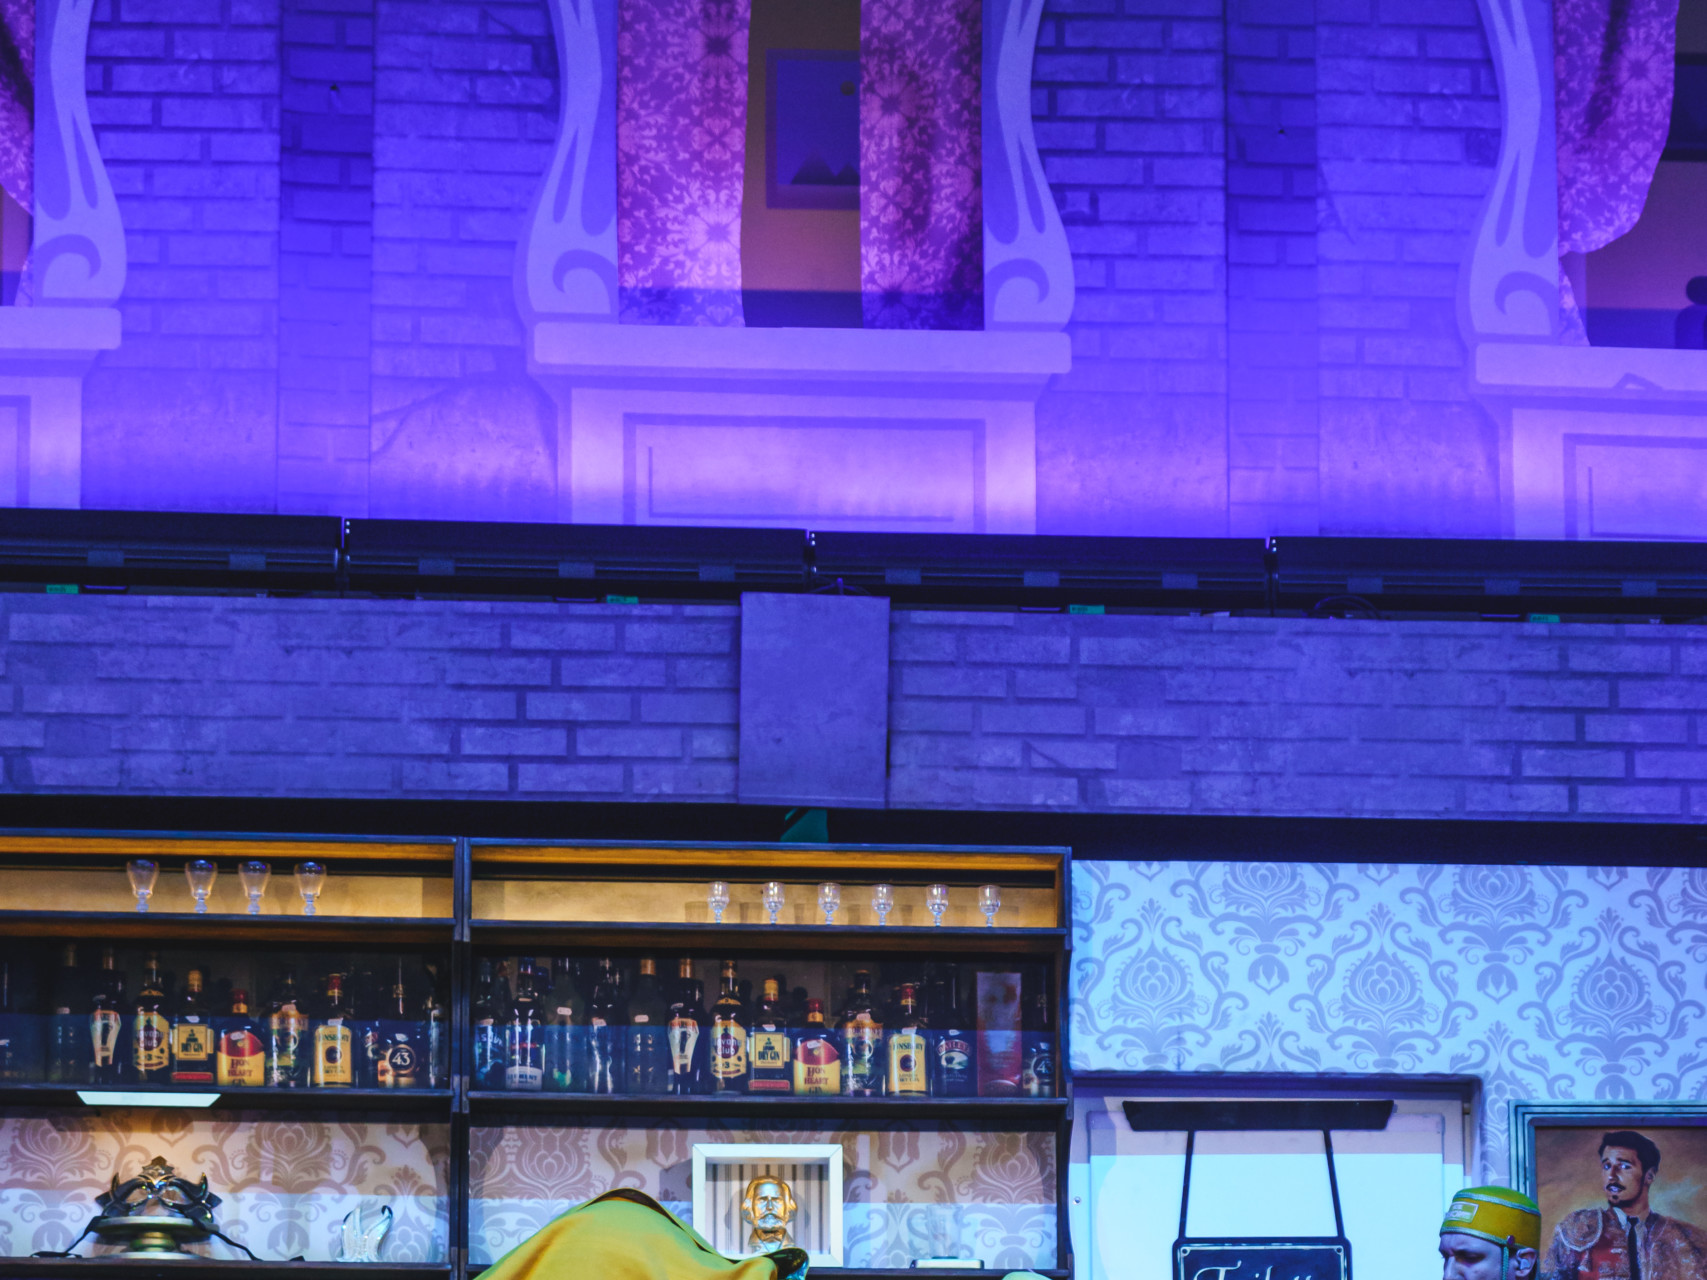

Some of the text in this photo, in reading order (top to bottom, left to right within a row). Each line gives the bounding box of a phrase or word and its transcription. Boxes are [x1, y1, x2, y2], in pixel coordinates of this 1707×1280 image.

[391, 1051, 411, 1066] 43
[757, 1050, 780, 1061] DRY GIN
